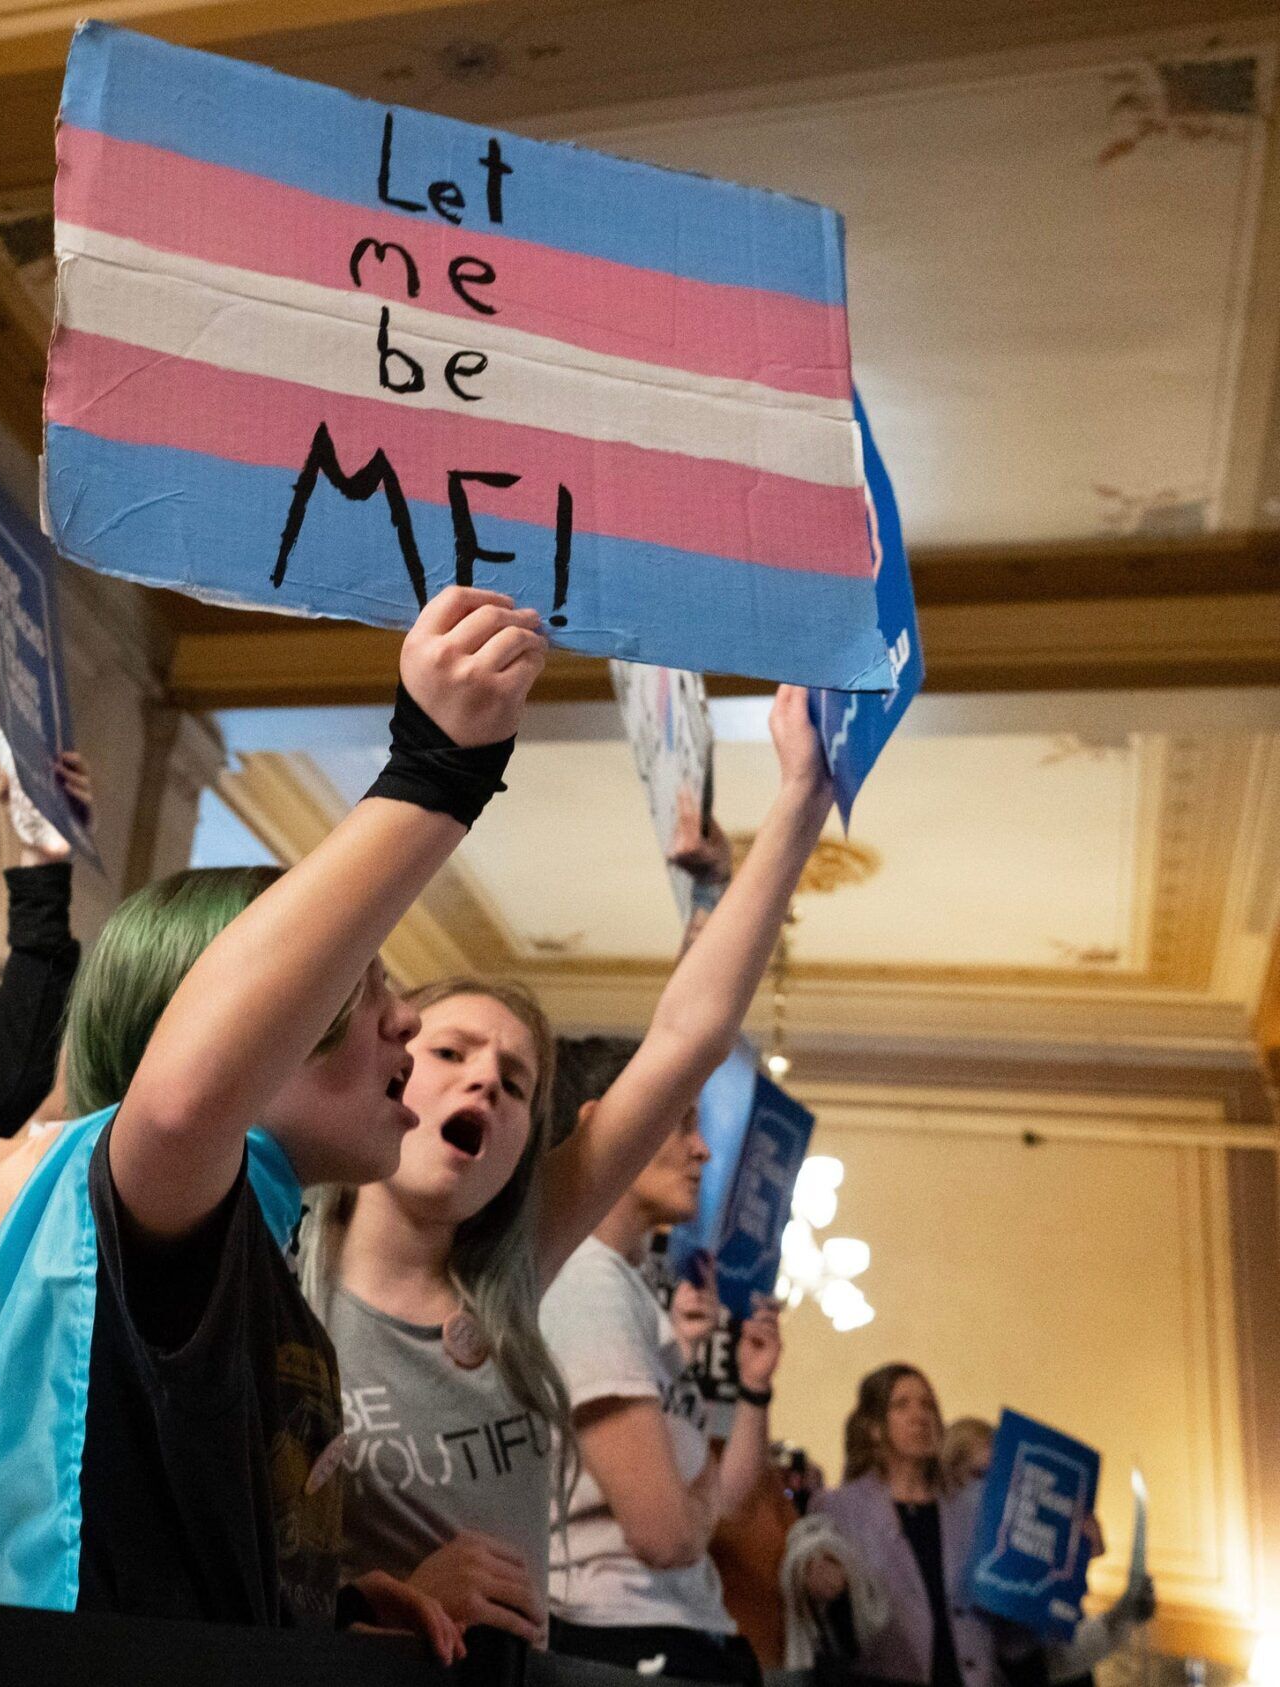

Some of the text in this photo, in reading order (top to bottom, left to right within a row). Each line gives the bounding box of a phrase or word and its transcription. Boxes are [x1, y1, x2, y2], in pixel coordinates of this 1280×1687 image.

[377, 110, 514, 226] Let
[349, 236, 500, 316] me
[376, 305, 489, 402] be
[270, 420, 574, 627] ME!
[339, 1385, 401, 1435] BE
